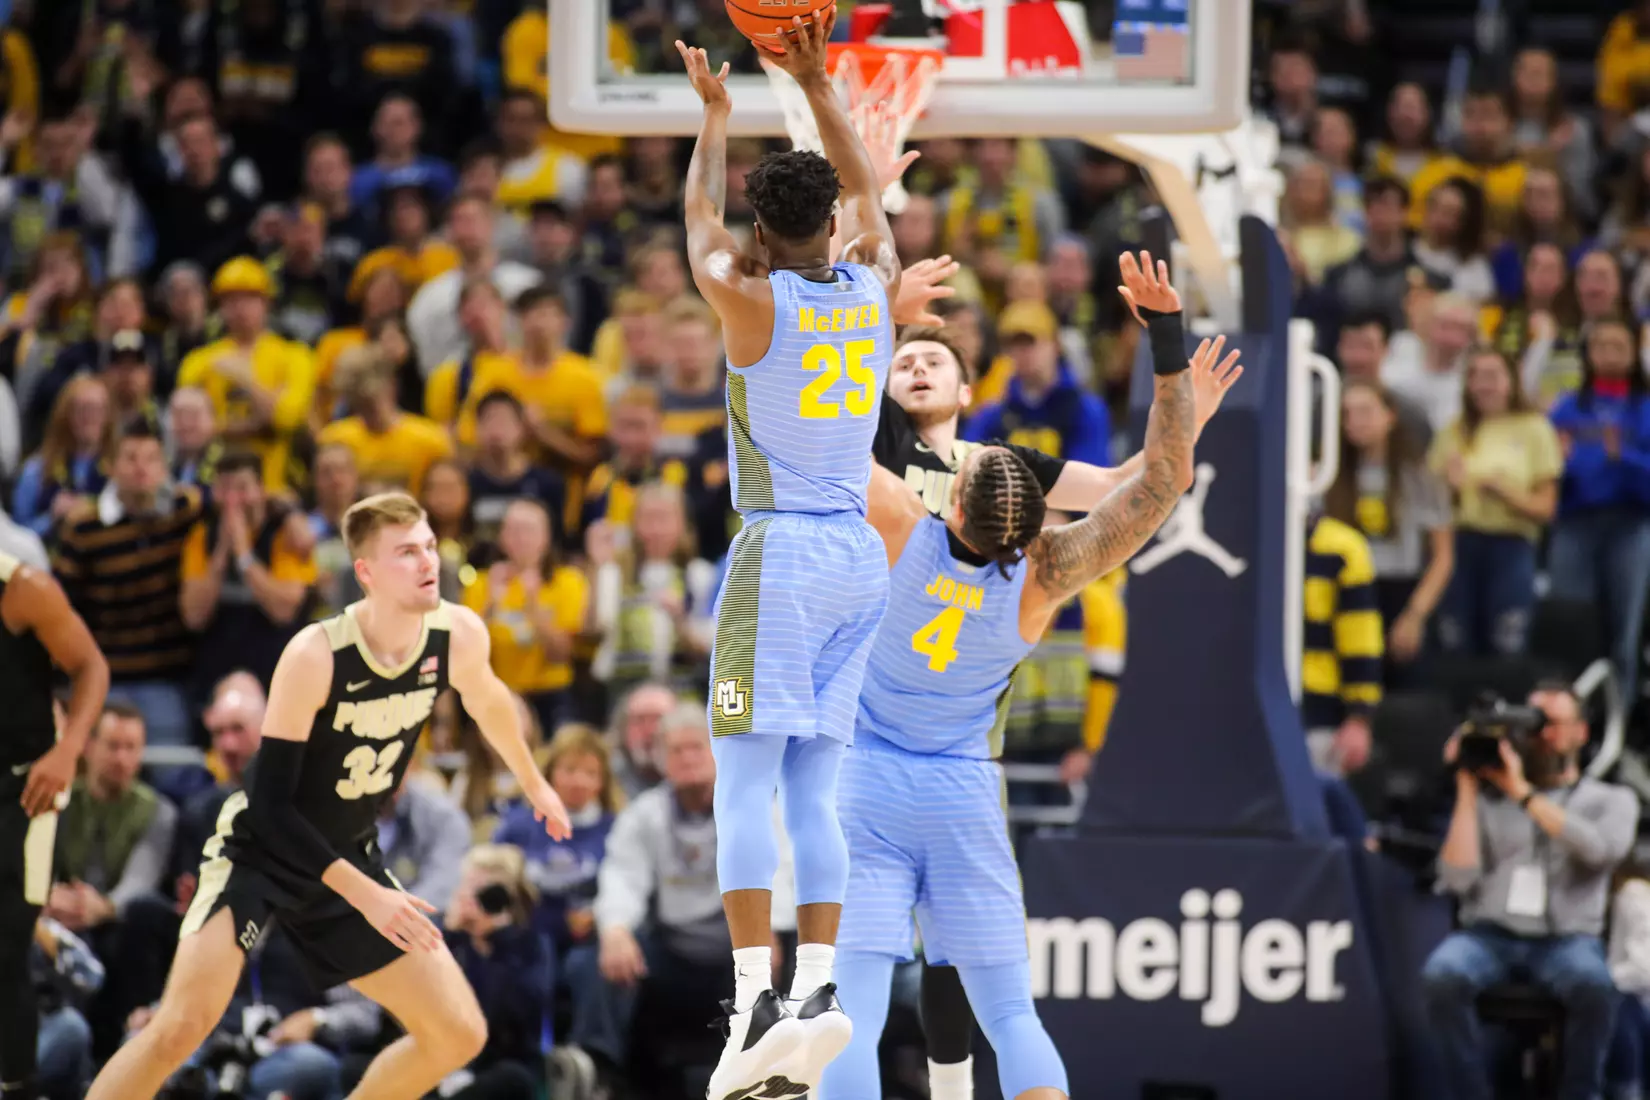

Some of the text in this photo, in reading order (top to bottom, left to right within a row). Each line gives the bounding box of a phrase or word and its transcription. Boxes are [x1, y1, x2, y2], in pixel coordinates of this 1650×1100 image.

[799, 303, 879, 332] McEWEN
[799, 339, 876, 418] 25
[925, 573, 984, 611] JOHN
[912, 605, 965, 672] 4
[715, 678, 748, 719] MU
[335, 740, 405, 800] 32
[1026, 888, 1353, 1026] meijer
